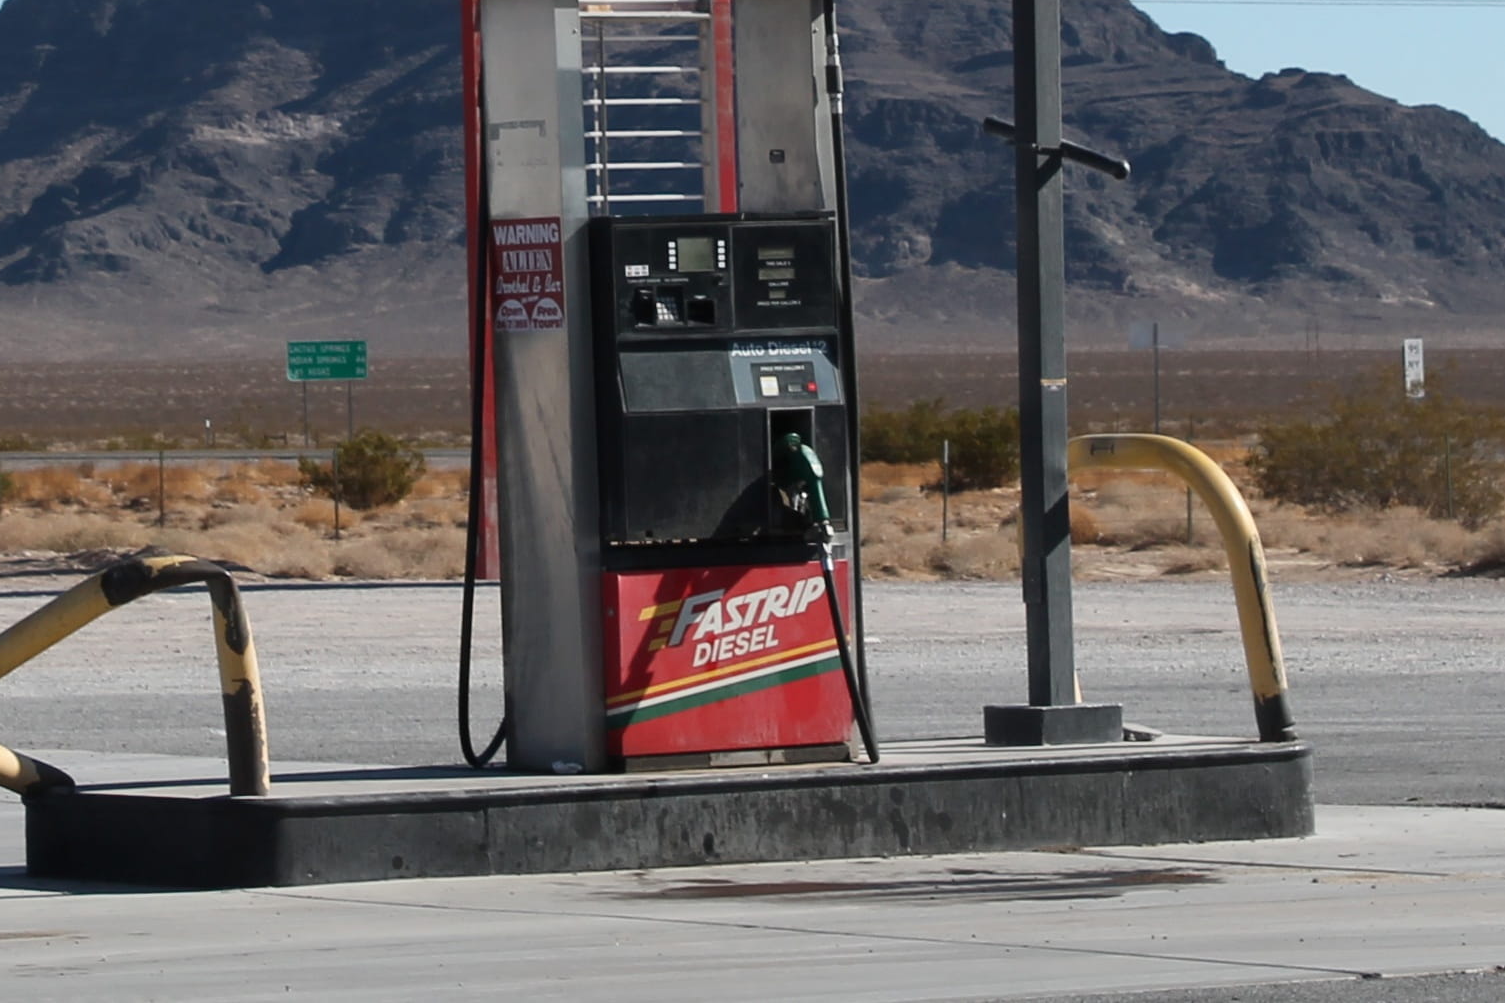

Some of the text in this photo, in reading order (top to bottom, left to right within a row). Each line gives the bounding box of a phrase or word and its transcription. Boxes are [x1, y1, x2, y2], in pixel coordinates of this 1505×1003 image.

[493, 223, 561, 246] WARNING
[731, 342, 765, 357] Auto
[768, 340, 812, 356] Diesel
[668, 576, 826, 647] FASTRIP
[692, 624, 780, 668] DIESEL
